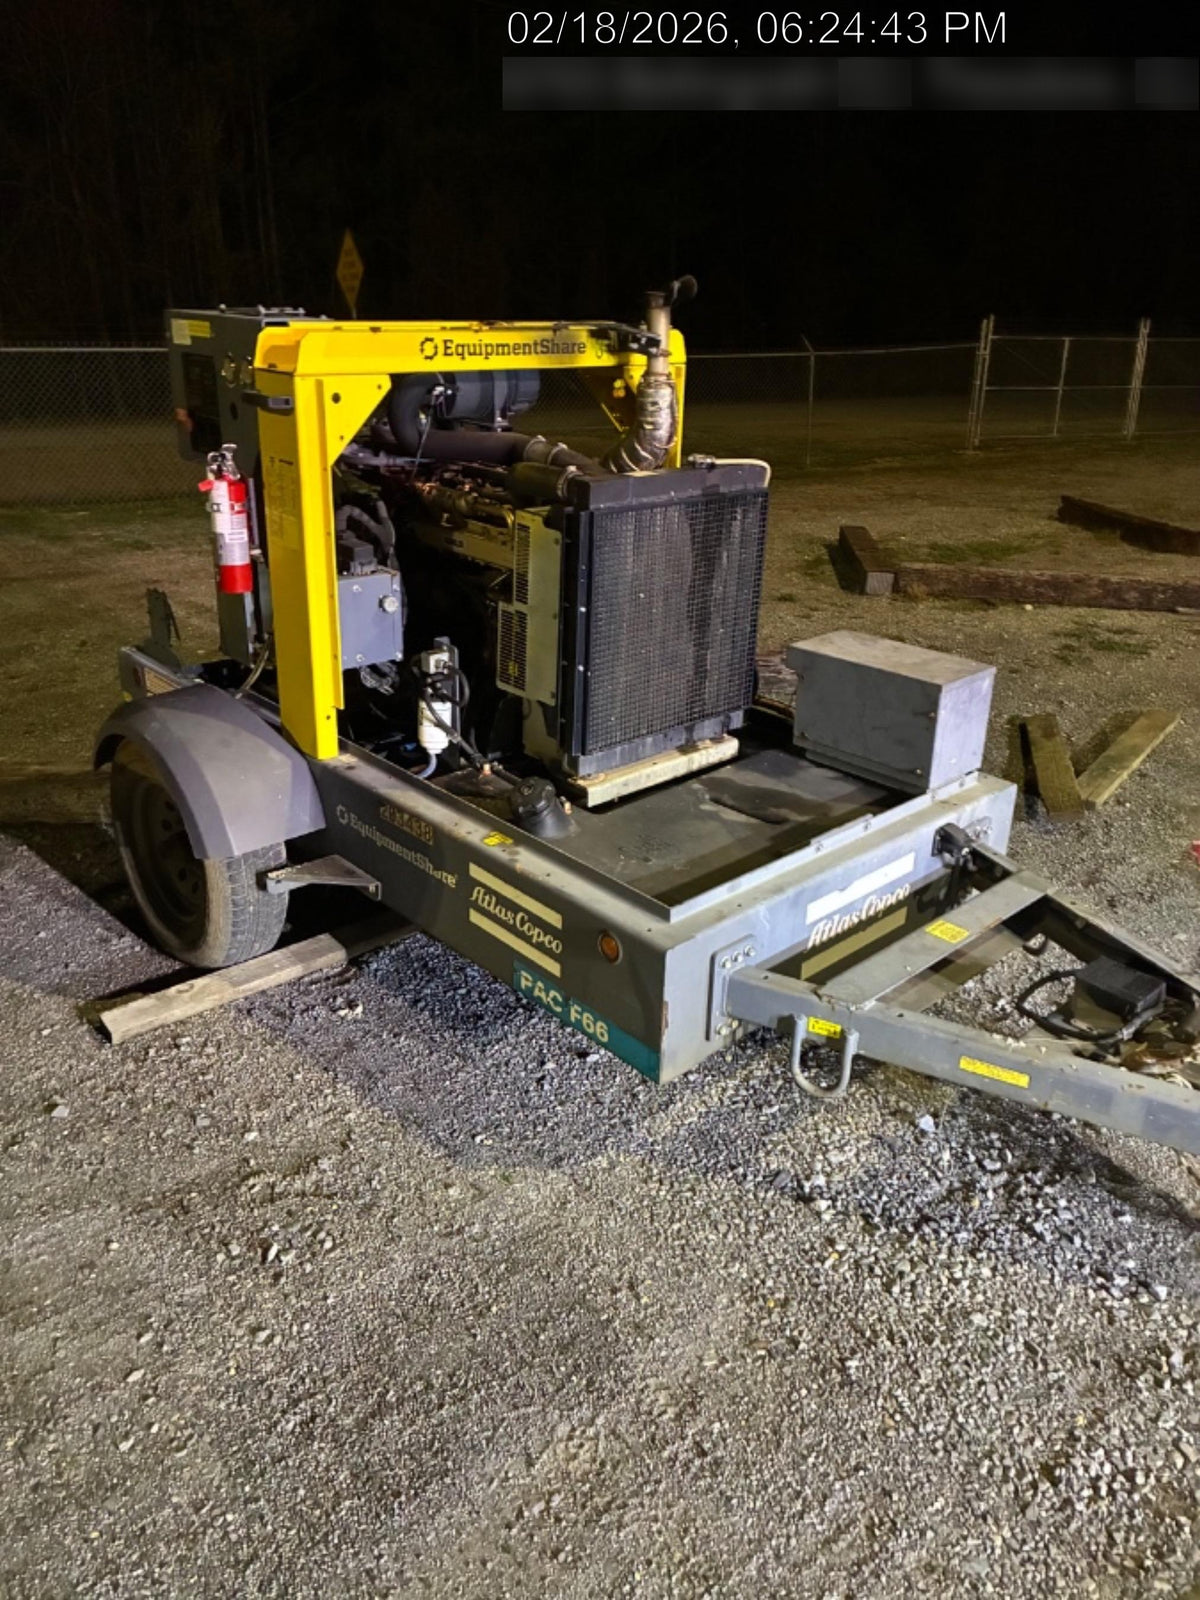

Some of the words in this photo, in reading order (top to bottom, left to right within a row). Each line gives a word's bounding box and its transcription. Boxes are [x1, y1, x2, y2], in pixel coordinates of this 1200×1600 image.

[443, 338, 587, 361] EquipmentShare
[349, 811, 457, 889] EquipmentShare
[519, 968, 564, 1013] PAC
[568, 1003, 610, 1044] F66
